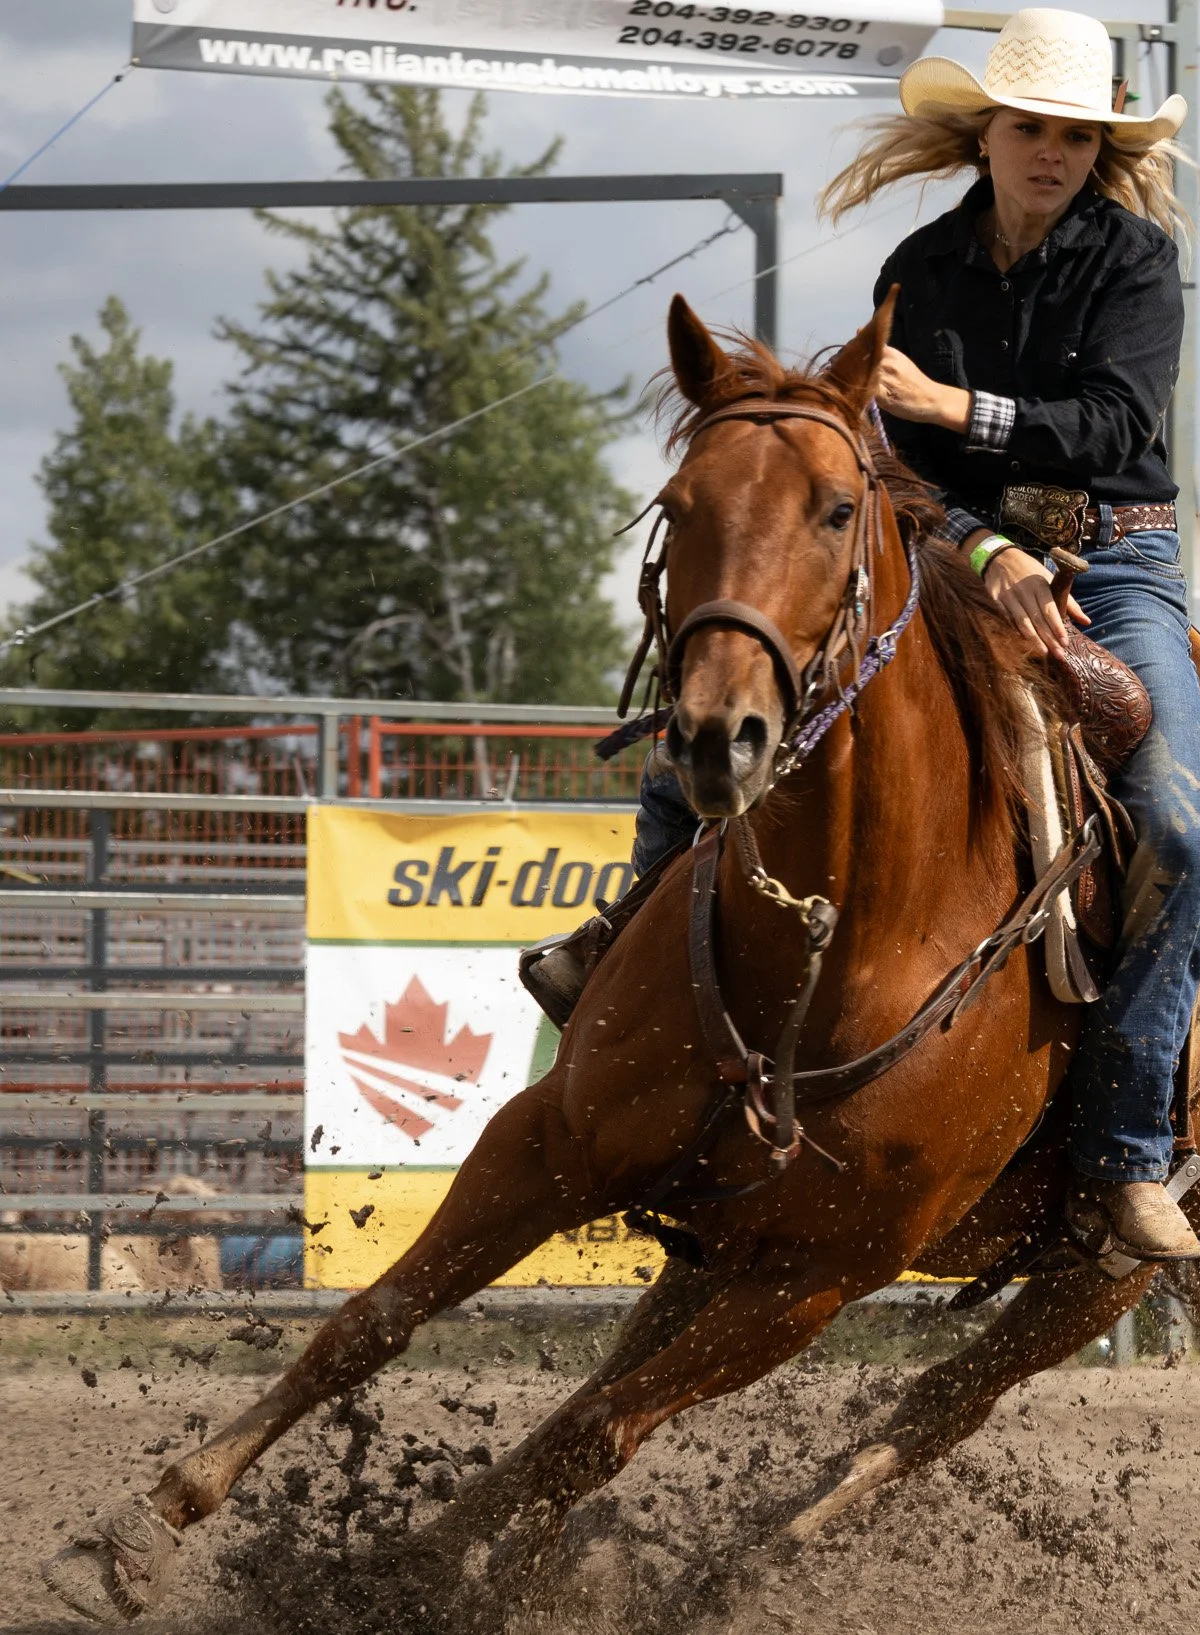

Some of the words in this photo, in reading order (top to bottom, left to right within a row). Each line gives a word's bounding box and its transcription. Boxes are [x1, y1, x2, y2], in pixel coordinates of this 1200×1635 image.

[627, 0, 871, 34] 204-392-9301
[619, 25, 860, 60] 204-392-6078
[199, 38, 858, 97] www.reliantcustomalloys.com
[1008, 490, 1035, 502] RODEO
[1049, 492, 1070, 503] 2024
[387, 846, 635, 909] ski-doo
